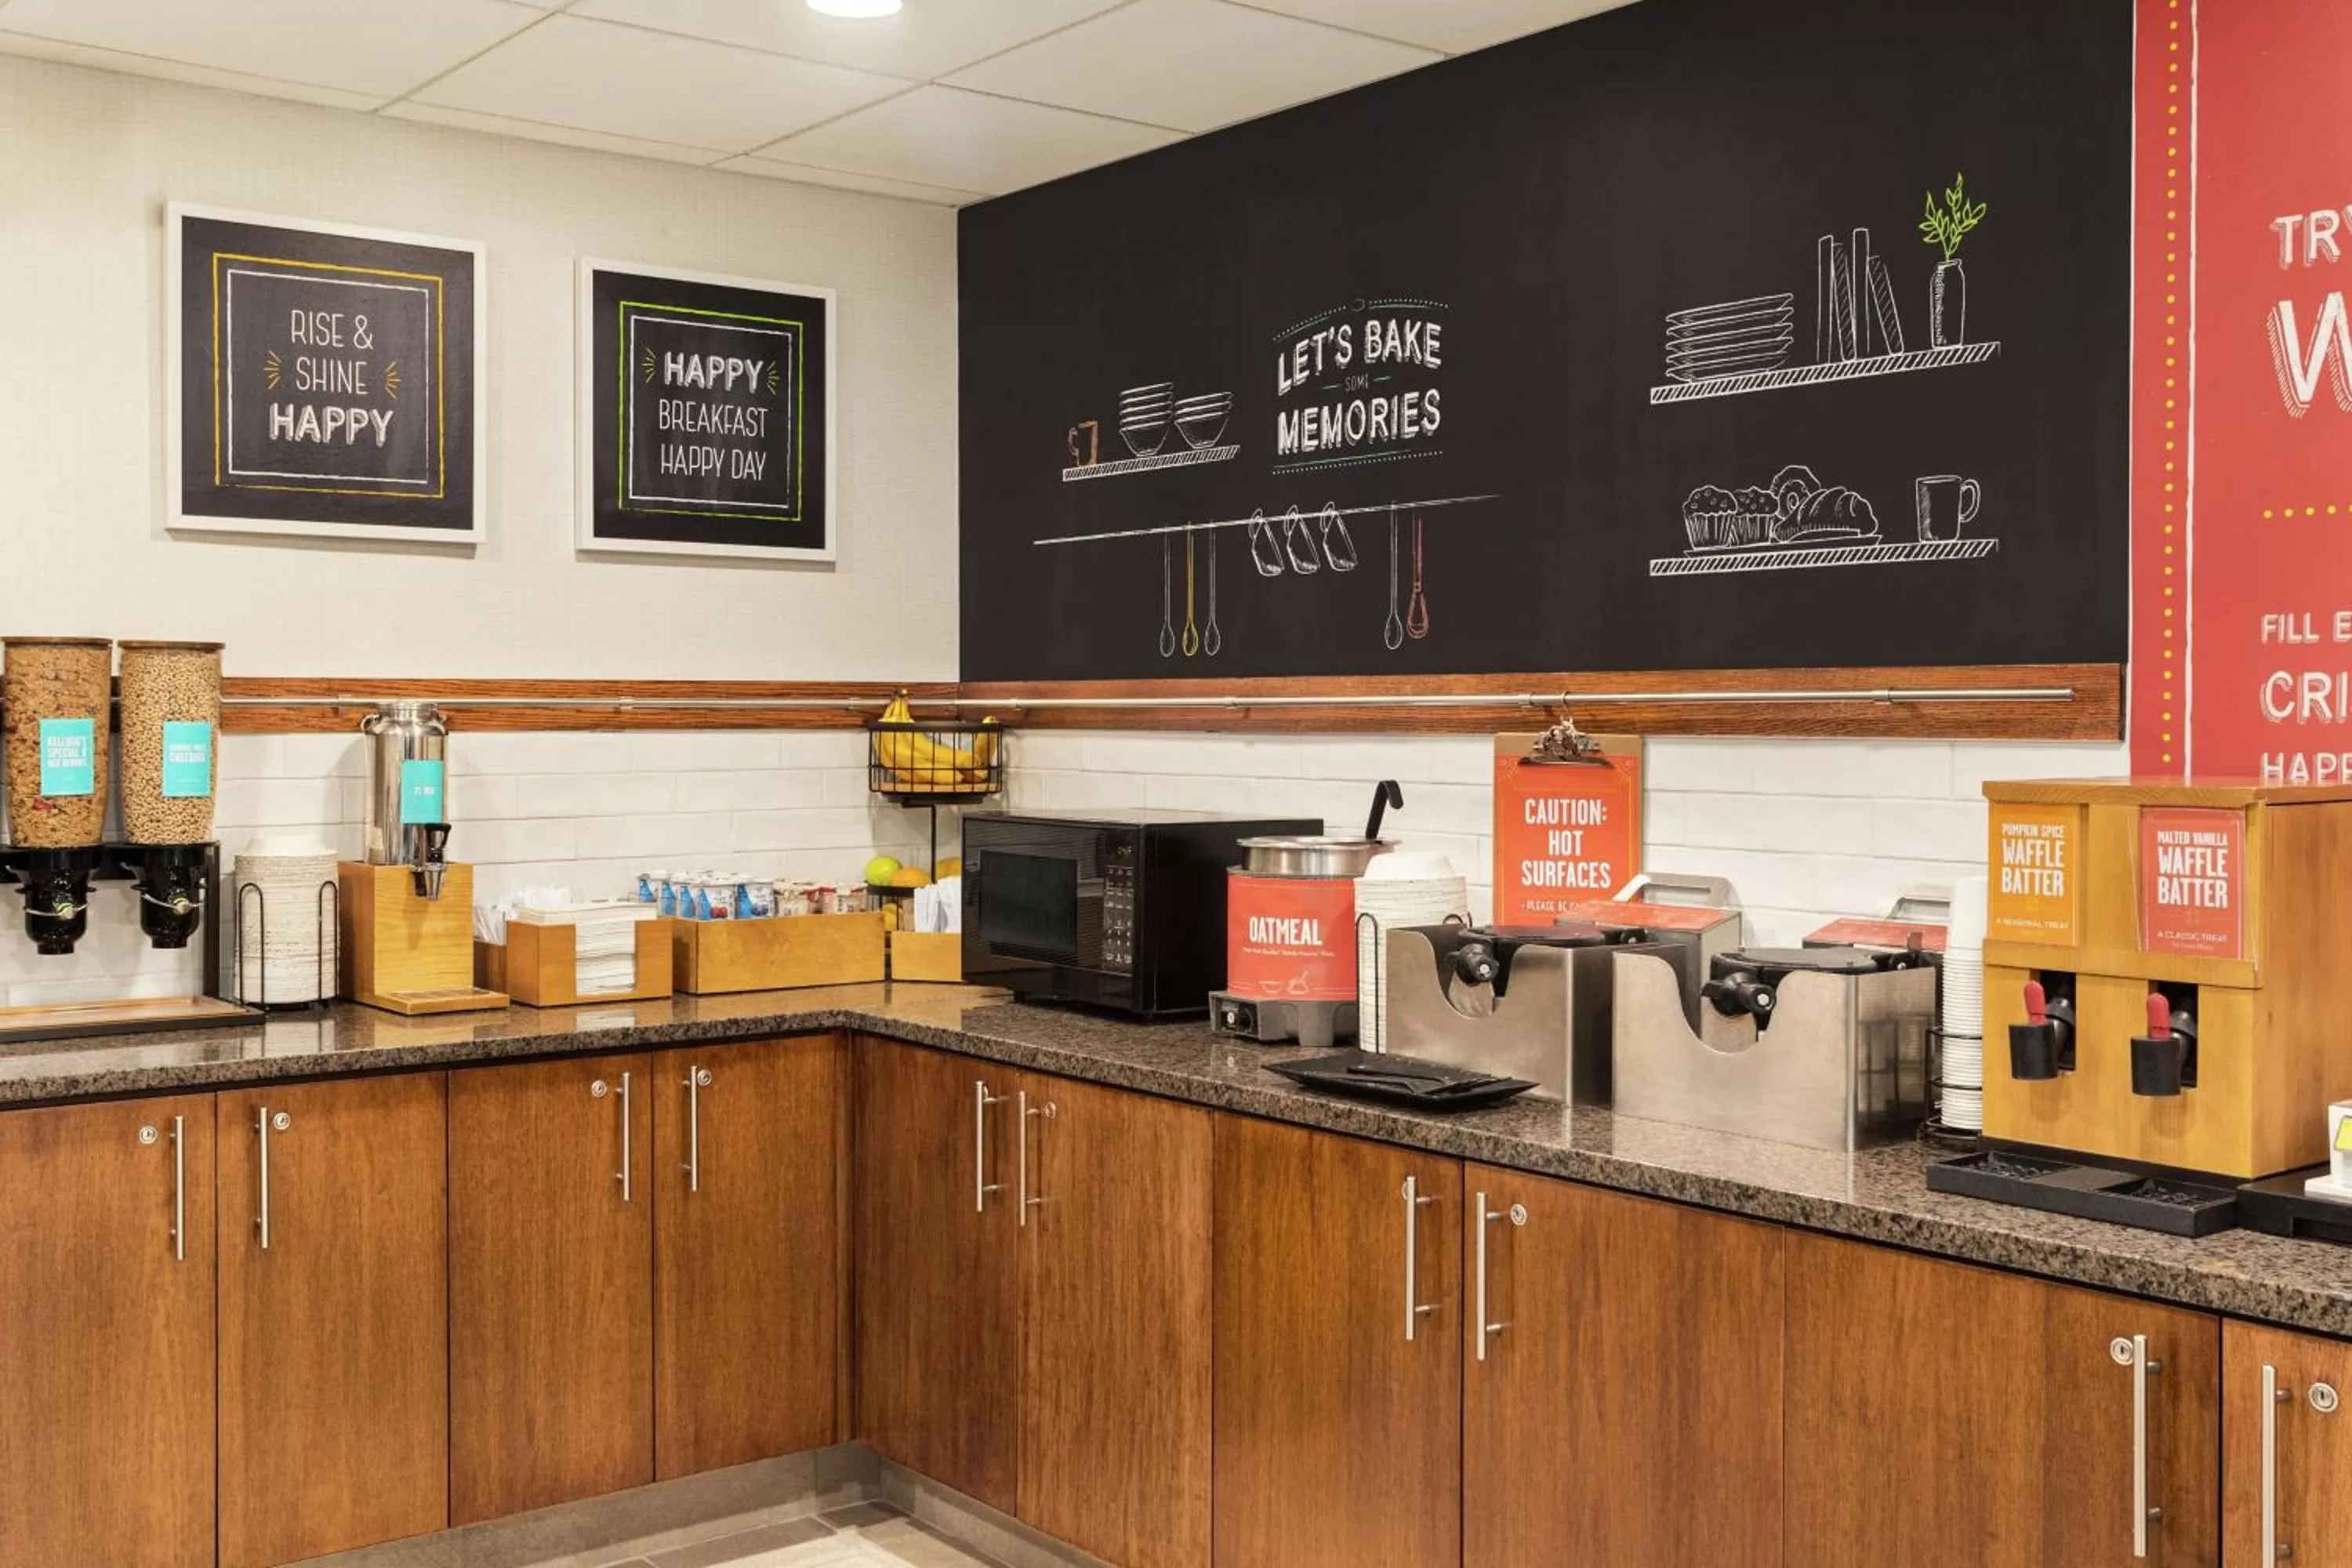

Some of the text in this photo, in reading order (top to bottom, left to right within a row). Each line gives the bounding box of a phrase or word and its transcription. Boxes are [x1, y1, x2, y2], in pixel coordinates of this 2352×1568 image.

[291, 310, 373, 350] RISE &
[664, 351, 764, 394] HAPPY
[1278, 318, 1442, 396] LET'S BAKE
[296, 357, 368, 394] SHINE
[269, 402, 394, 448] HAPPY
[659, 398, 768, 437] BREAKFAST
[1277, 389, 1441, 456] MEMORIES
[661, 443, 767, 481] HAPPY DAY
[2261, 612, 2320, 644] FILL
[2259, 670, 2352, 724] CRI
[1524, 798, 1607, 825] CAUTION:
[1548, 829, 1584, 856] HOT
[2002, 823, 2065, 838] PUMPKIN SPICE
[2158, 830, 2228, 845] MALTED VANILLA
[2002, 838, 2066, 868] WAFFLE
[2158, 846, 2228, 877] WAFFLE
[1522, 859, 1611, 888] SURFACES
[2002, 866, 2064, 897] BATTER
[1526, 901, 1555, 911] PLEASE
[2158, 877, 2227, 909] BATTER
[1249, 916, 1323, 946] OATMEAL
